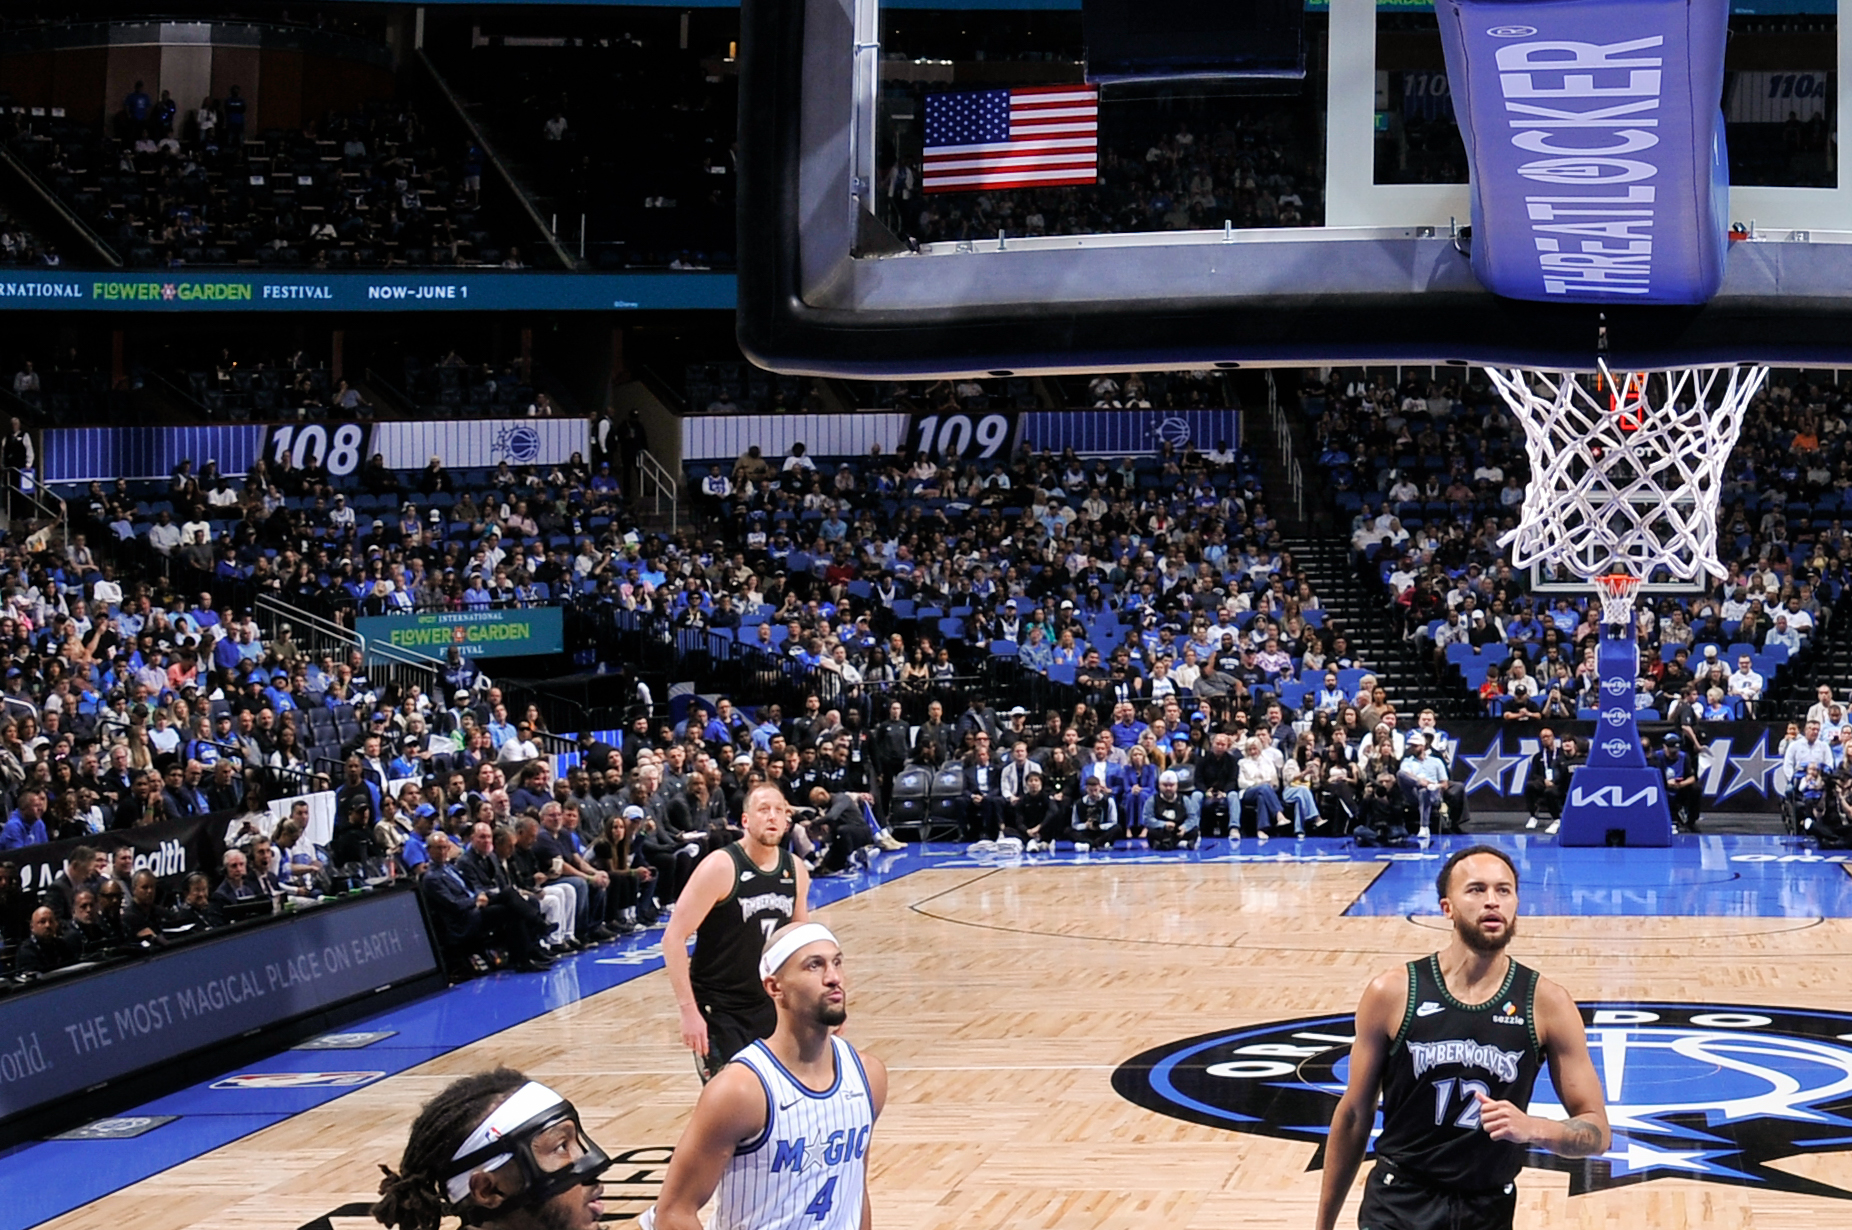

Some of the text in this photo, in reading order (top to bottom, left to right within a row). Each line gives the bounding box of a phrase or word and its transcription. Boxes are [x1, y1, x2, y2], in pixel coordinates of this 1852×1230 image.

[1404, 74, 1450, 97] 110
[1769, 75, 1824, 98] 110A
[93, 282, 160, 300] FLOWER
[177, 283, 251, 300] GARDEN
[263, 286, 332, 299] FESTIVAL
[273, 424, 363, 476] 108
[918, 415, 1008, 459] 109
[1602, 447, 1654, 457] TOT
[467, 623, 530, 642] GARDEN
[760, 918, 779, 941] 7
[65, 1015, 113, 1055] THE
[114, 997, 175, 1040] MOST
[178, 970, 265, 1021] MAGICAL
[269, 952, 323, 991] PLACE
[324, 946, 351, 974] ON
[353, 928, 401, 966] EARTH
[1406, 1039, 1525, 1083] TIMBERWOLVES
[1431, 1077, 1491, 1130] 12
[805, 1175, 840, 1221] 4
